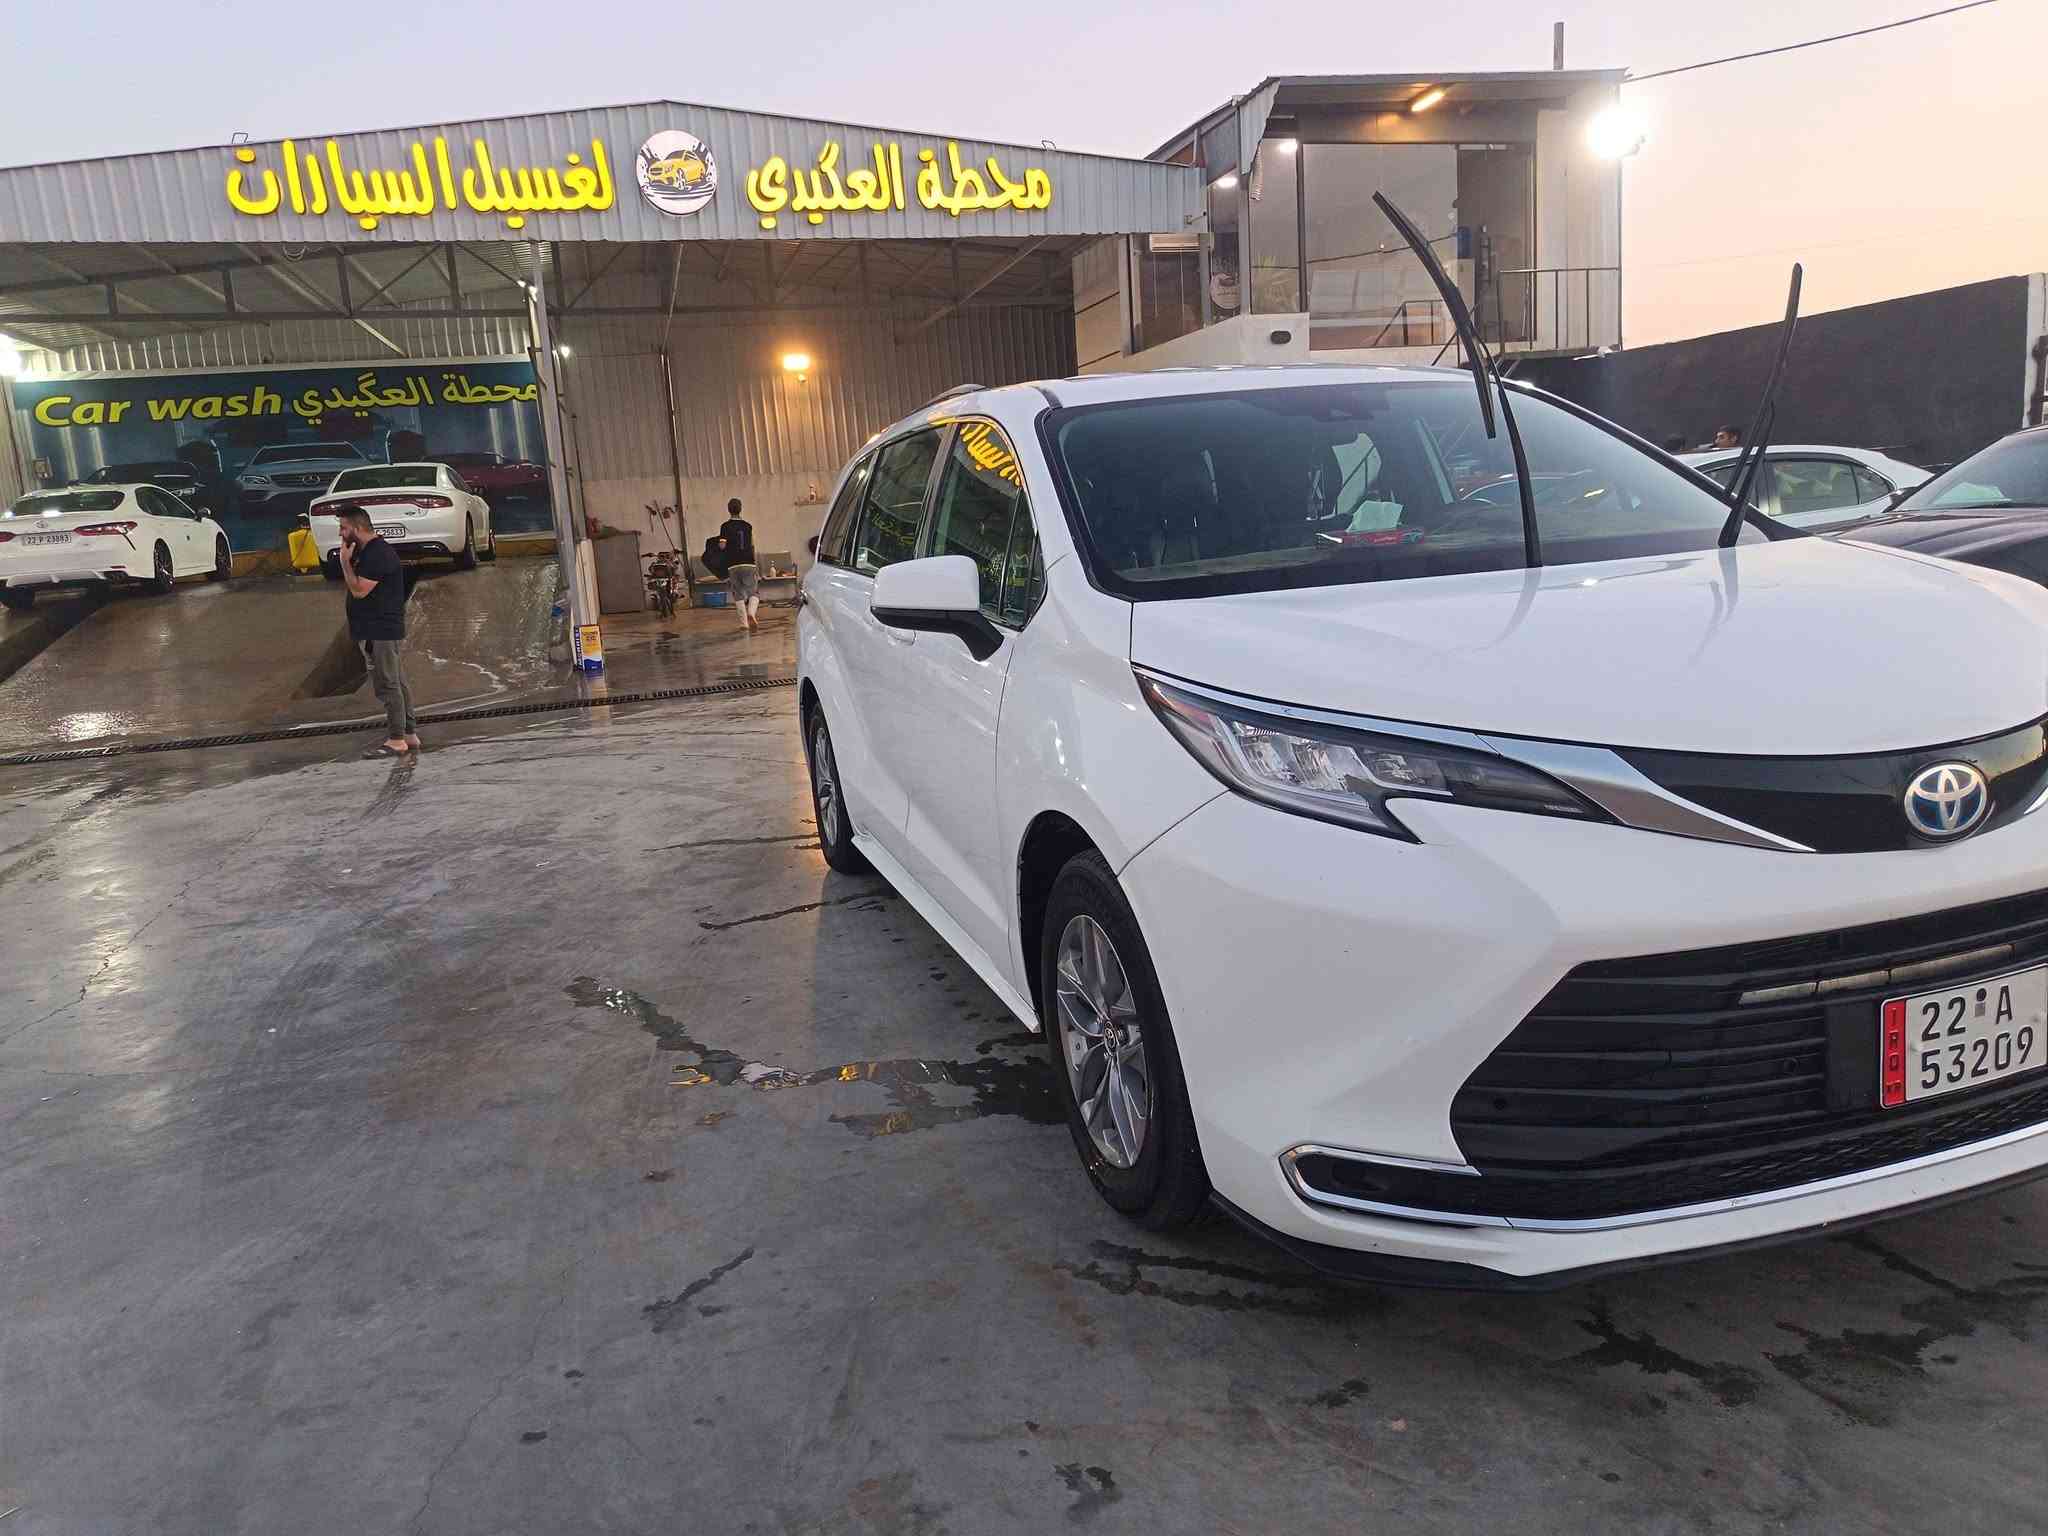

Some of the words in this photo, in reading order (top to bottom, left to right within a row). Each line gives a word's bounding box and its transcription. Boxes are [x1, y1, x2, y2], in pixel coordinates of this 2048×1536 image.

[226, 137, 458, 231] السيارات
[462, 138, 615, 230] لغسيل
[917, 141, 1053, 218] محطة
[33, 394, 132, 427] Car
[146, 385, 282, 423] wash
[442, 373, 537, 405] محطة
[1921, 996, 1967, 1042] 22
[1995, 984, 2014, 1025] A
[1920, 1025, 2034, 1090] 53209
